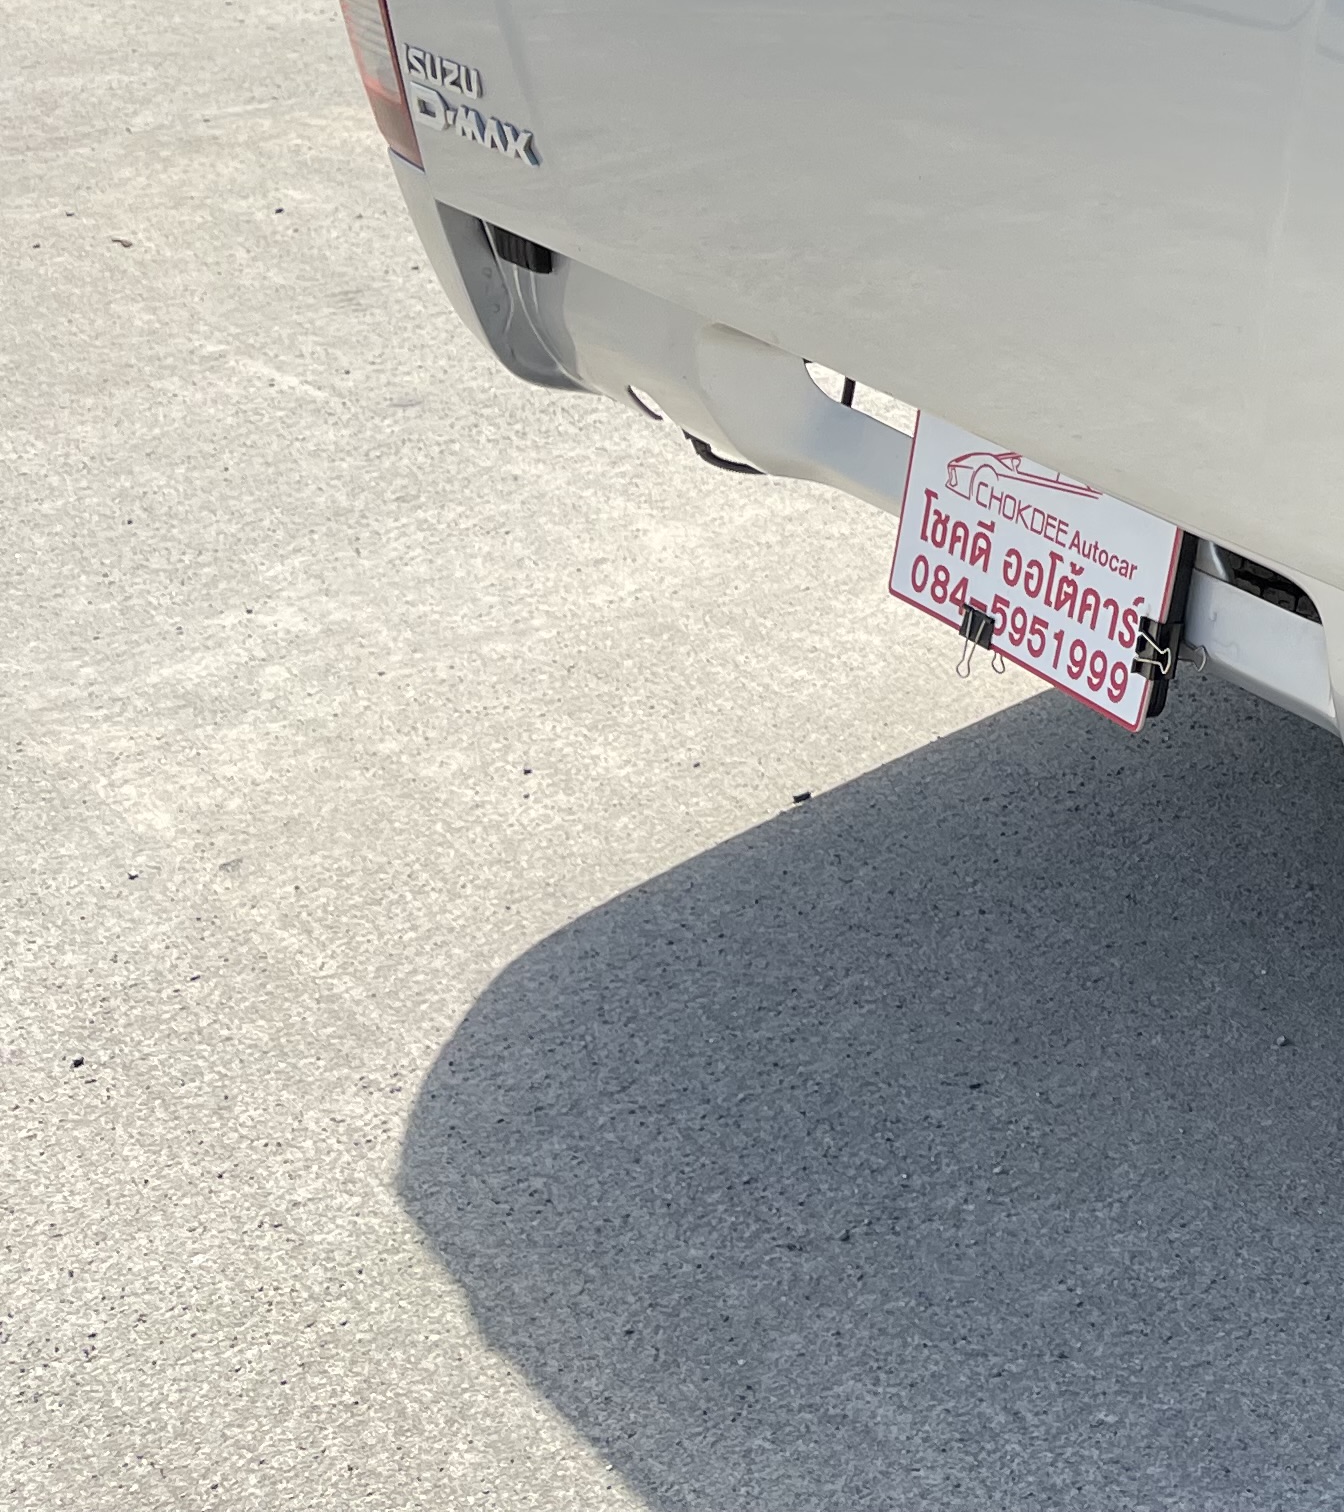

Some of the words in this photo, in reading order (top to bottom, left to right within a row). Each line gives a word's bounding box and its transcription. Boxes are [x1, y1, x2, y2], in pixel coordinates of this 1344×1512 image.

[401, 42, 484, 100] ISUZU
[920, 487, 996, 573] โชคดี
[1003, 548, 1146, 648] ออโต้คาร์
[975, 481, 1069, 548] CHOKDEE
[1069, 530, 1138, 580] Autocar
[911, 554, 1129, 703] 084-5951999
